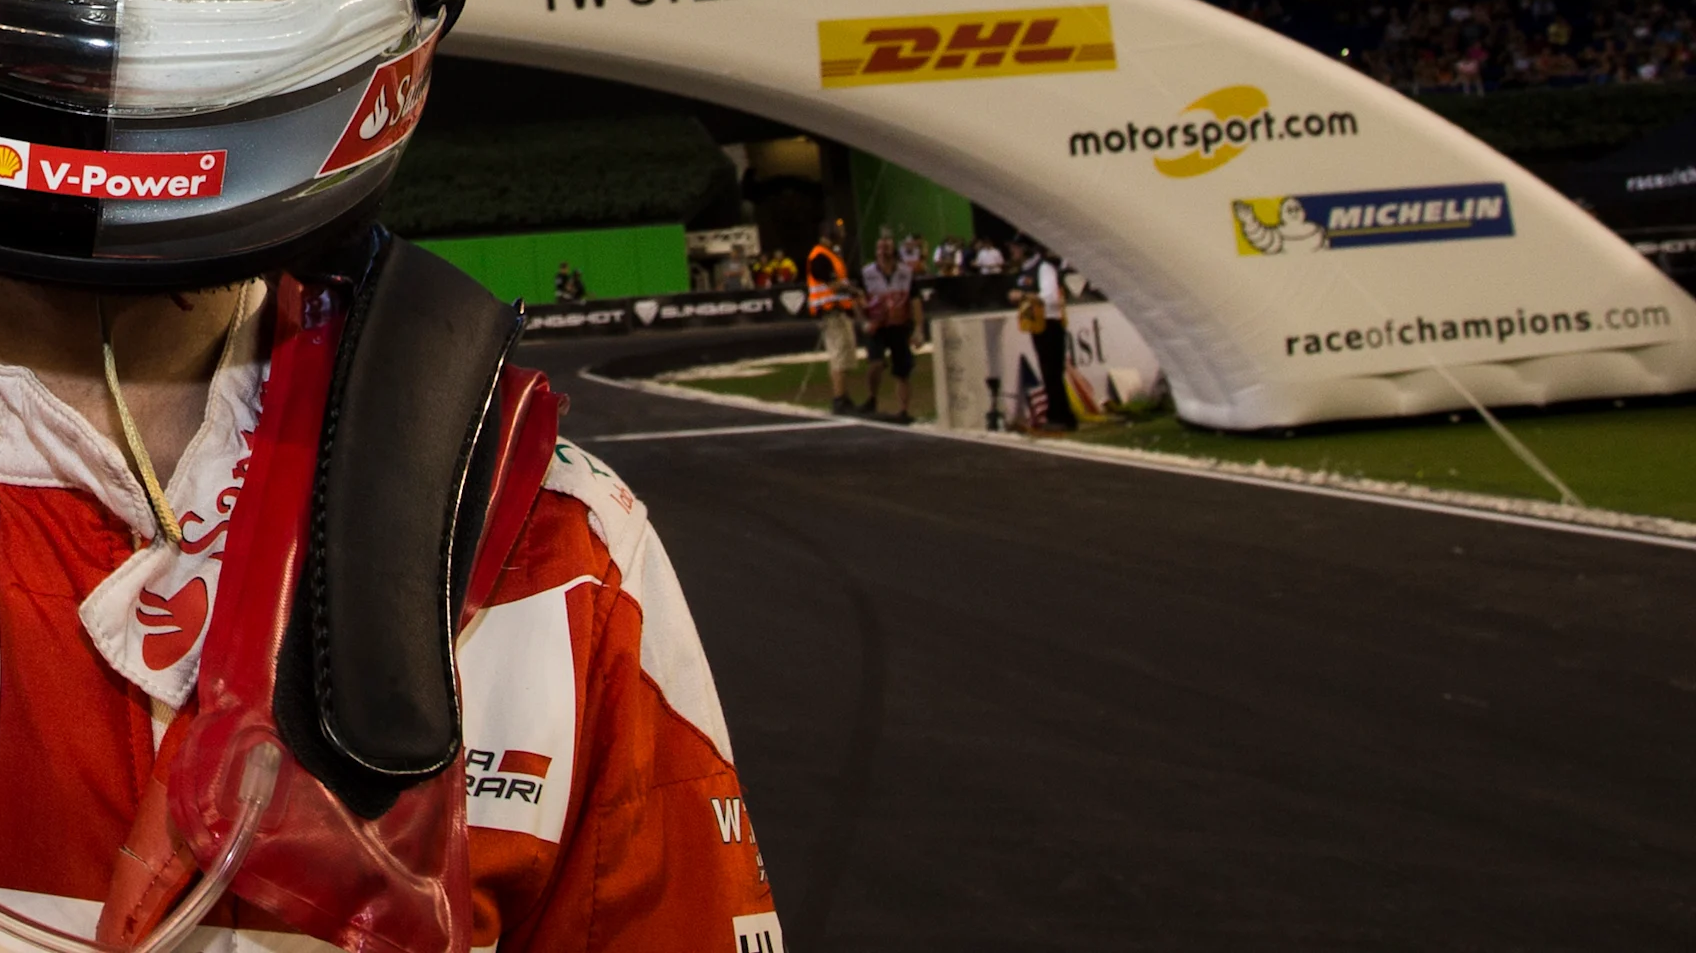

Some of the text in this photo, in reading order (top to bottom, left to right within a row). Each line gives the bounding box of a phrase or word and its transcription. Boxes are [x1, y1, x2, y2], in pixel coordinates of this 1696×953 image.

[863, 17, 1082, 74] DHL
[1069, 109, 1358, 158] motorsport.com
[1326, 196, 1504, 230] MICHELIN
[1285, 302, 1671, 358] raceofchampions.com
